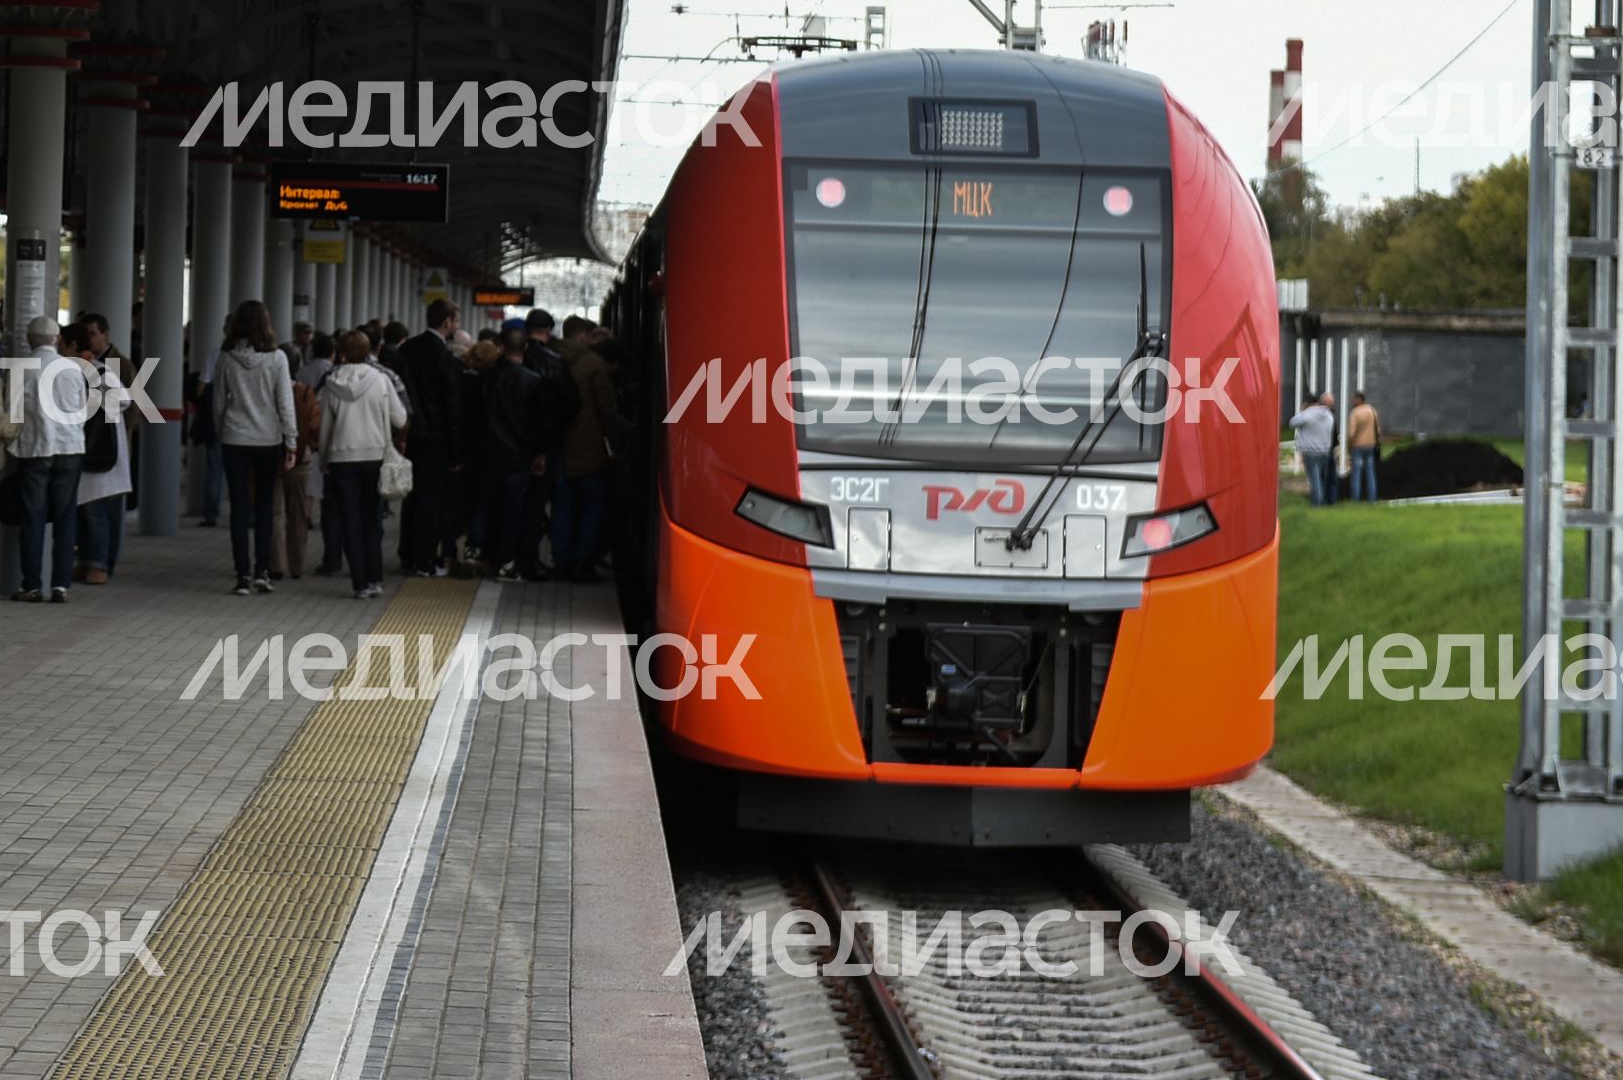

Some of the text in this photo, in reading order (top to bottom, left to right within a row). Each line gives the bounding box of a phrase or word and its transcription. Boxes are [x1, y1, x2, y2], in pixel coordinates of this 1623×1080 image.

[406, 173, 438, 185] 16:17
[953, 181, 993, 217] МЦК
[830, 476, 890, 503] ЭС2Г
[1076, 484, 1128, 511] 037
